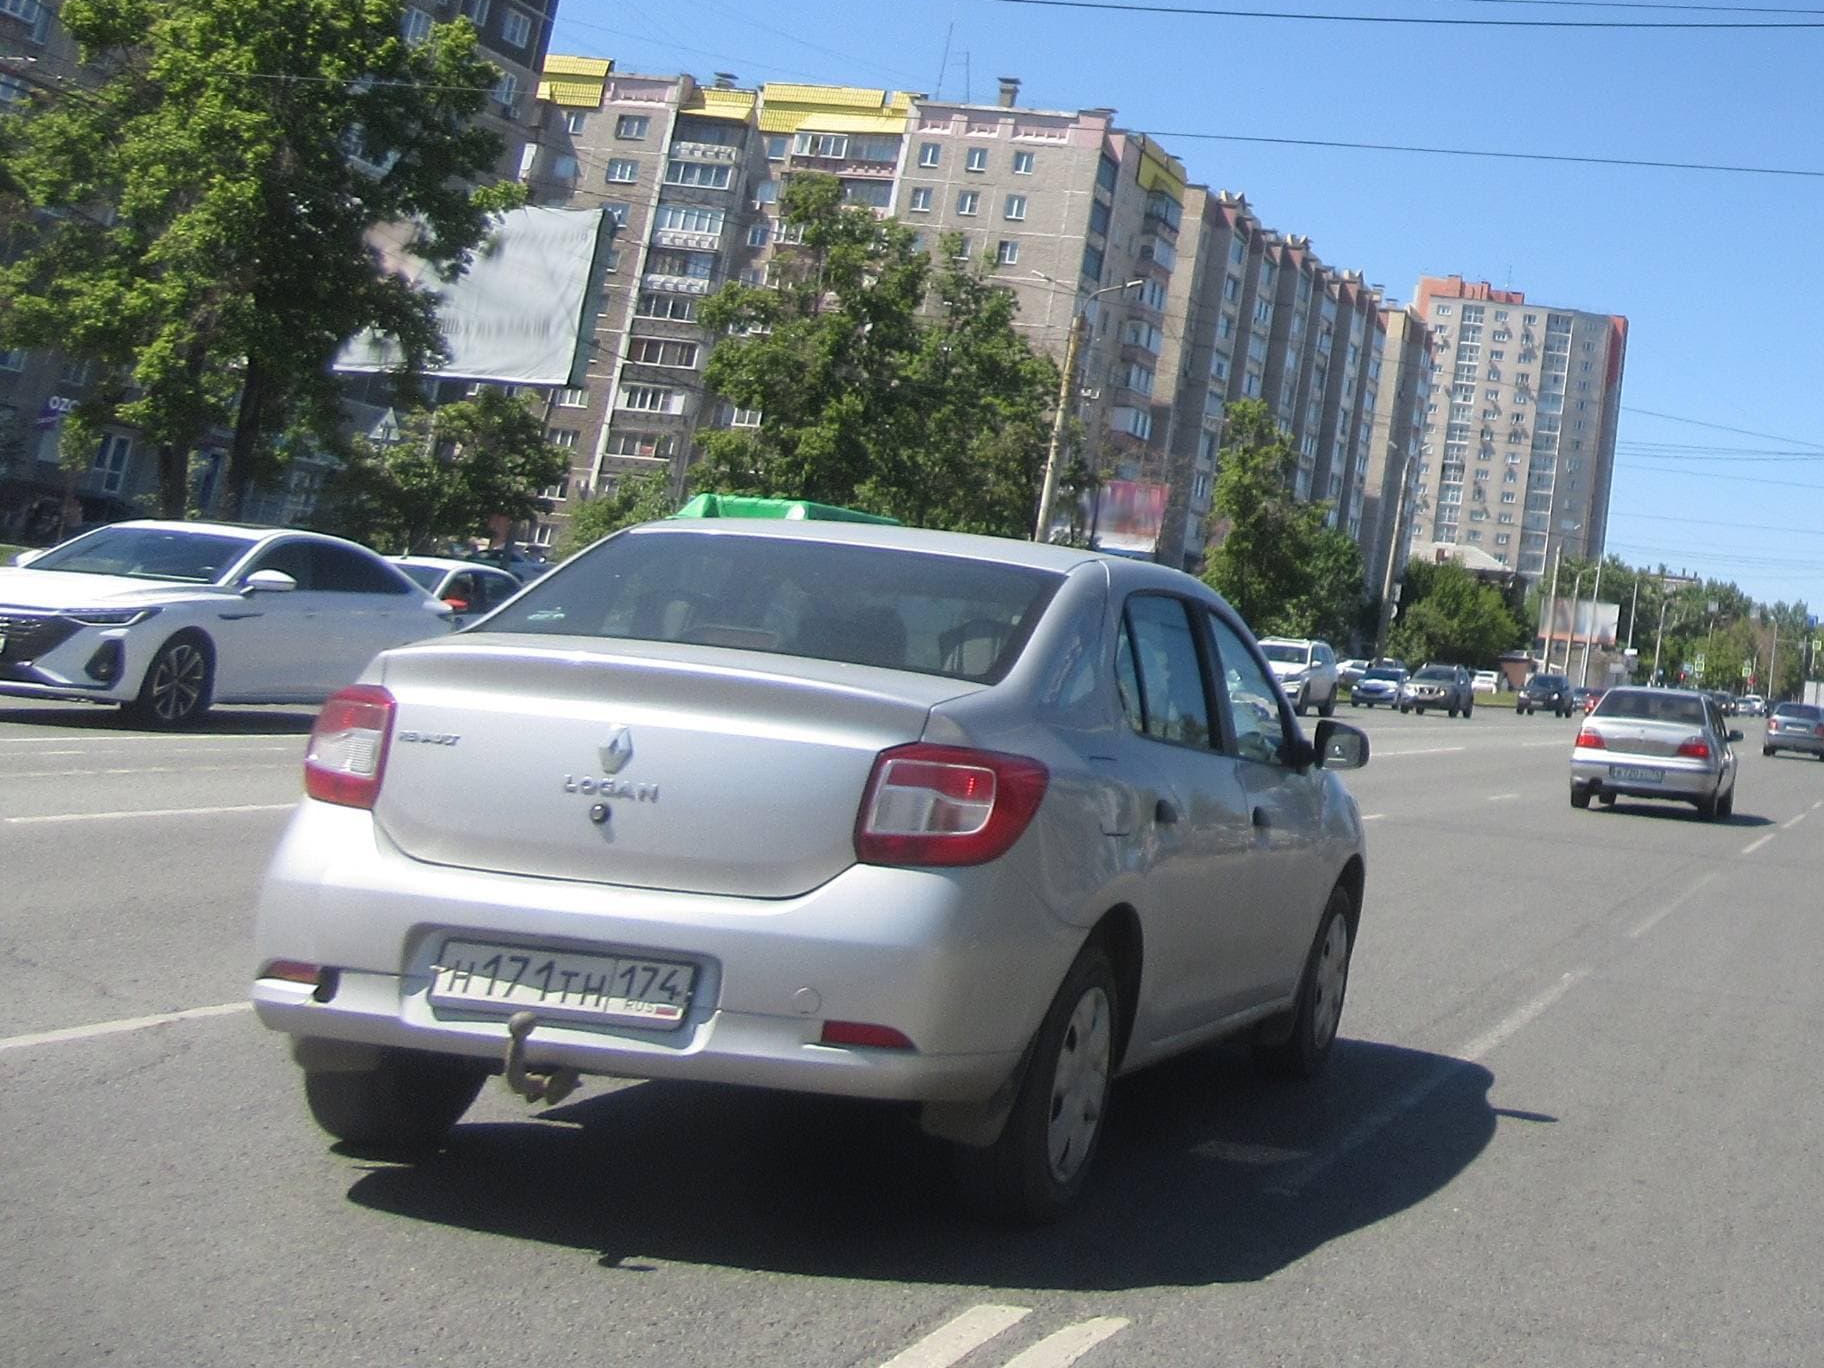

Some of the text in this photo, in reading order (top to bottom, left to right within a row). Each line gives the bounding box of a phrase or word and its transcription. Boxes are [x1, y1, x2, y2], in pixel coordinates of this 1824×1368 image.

[49, 395, 81, 412] OZ
[564, 774, 659, 802] LOGAN
[619, 965, 681, 1001] 174
